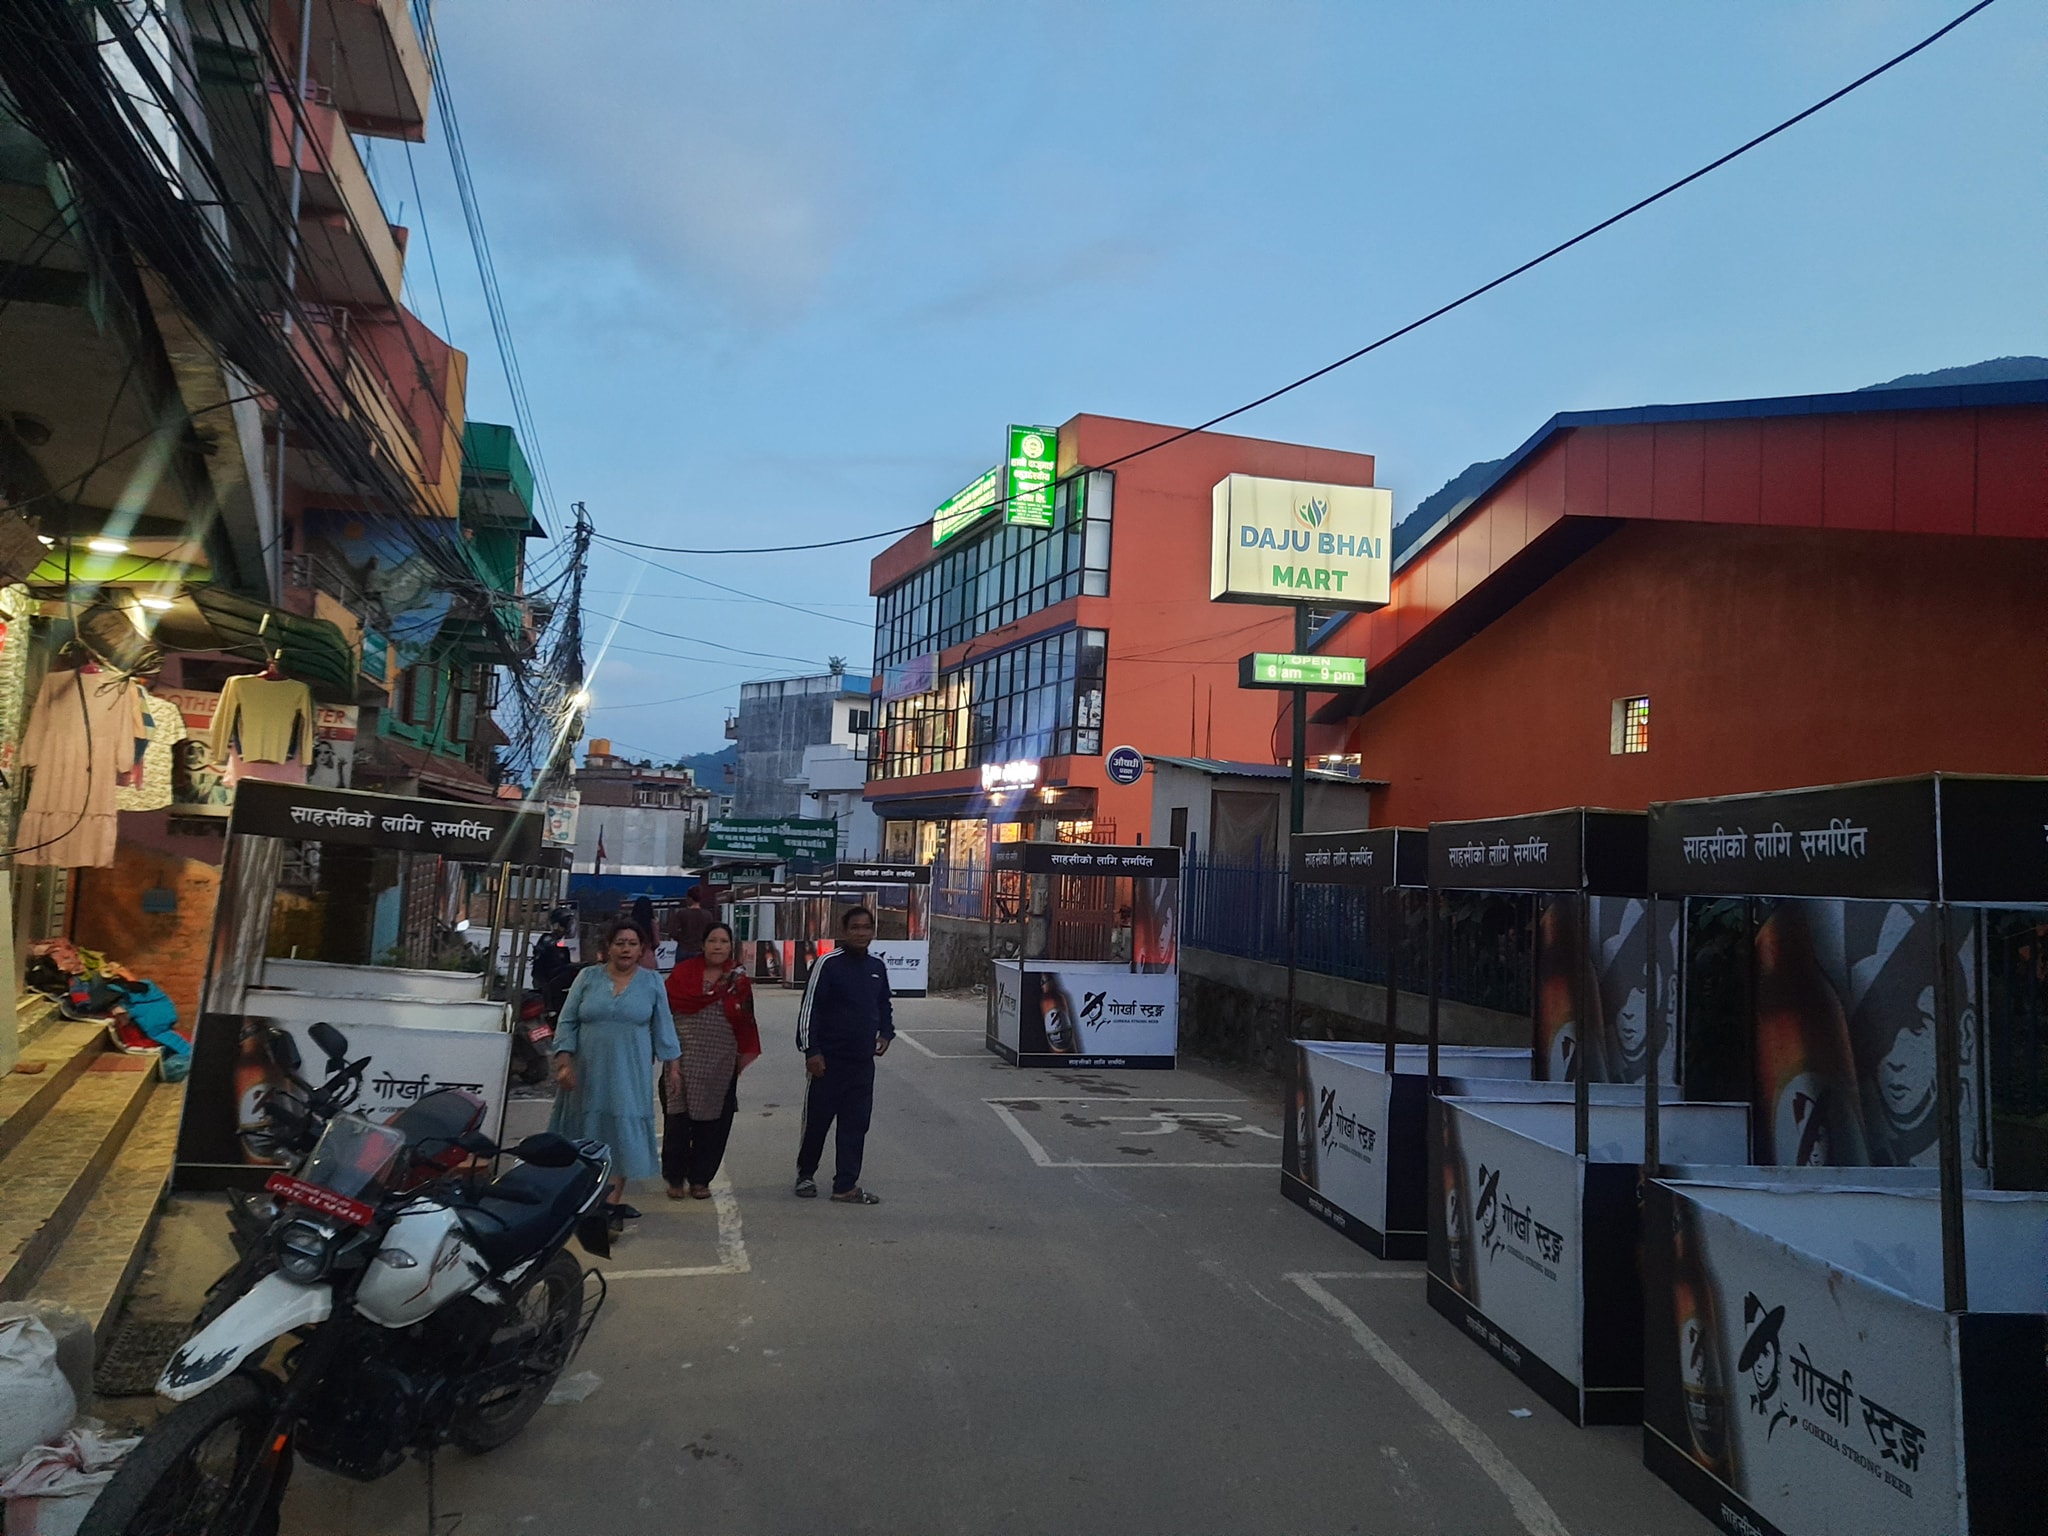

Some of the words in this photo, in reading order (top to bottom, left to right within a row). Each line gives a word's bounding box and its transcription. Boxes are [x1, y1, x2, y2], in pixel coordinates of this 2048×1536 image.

[1240, 525, 1310, 552] DAJU
[1318, 532, 1381, 559] BHAI
[1272, 565, 1349, 591] MART
[1268, 665, 1277, 678] 6
[1281, 668, 1302, 679] am
[1321, 668, 1329, 680] 9
[1334, 671, 1355, 683] pm
[1291, 656, 1330, 666] OPEN
[290, 806, 375, 828] साहसीको
[381, 813, 424, 834] लागि
[431, 819, 494, 841] समर्पित
[1448, 841, 1485, 868] साहसीको
[1488, 838, 1511, 864] लागि
[1513, 836, 1549, 866] समर्पित
[1683, 826, 1748, 864] साहसीको
[1754, 821, 1793, 861] लागि
[1800, 818, 1868, 863] समर्पित
[1051, 853, 1094, 866] साहसीको
[1096, 853, 1119, 866] लागि
[1121, 854, 1154, 867] समर्पित
[1304, 848, 1331, 869] साहसीको
[1333, 847, 1348, 867] लागि
[1349, 846, 1374, 868] समर्पित
[711, 872, 728, 880] ATM
[741, 868, 762, 877] ATM
[1107, 999, 1137, 1016] गोर्खा
[1336, 1106, 1356, 1139] गोर्खा
[1501, 1193, 1532, 1244] गोर्खा
[1789, 1342, 1854, 1427] गोर्खा
[1801, 1418, 1841, 1452] GORKHA
[1841, 1443, 1882, 1478] STRONG
[1884, 1469, 1914, 1499] BEER
